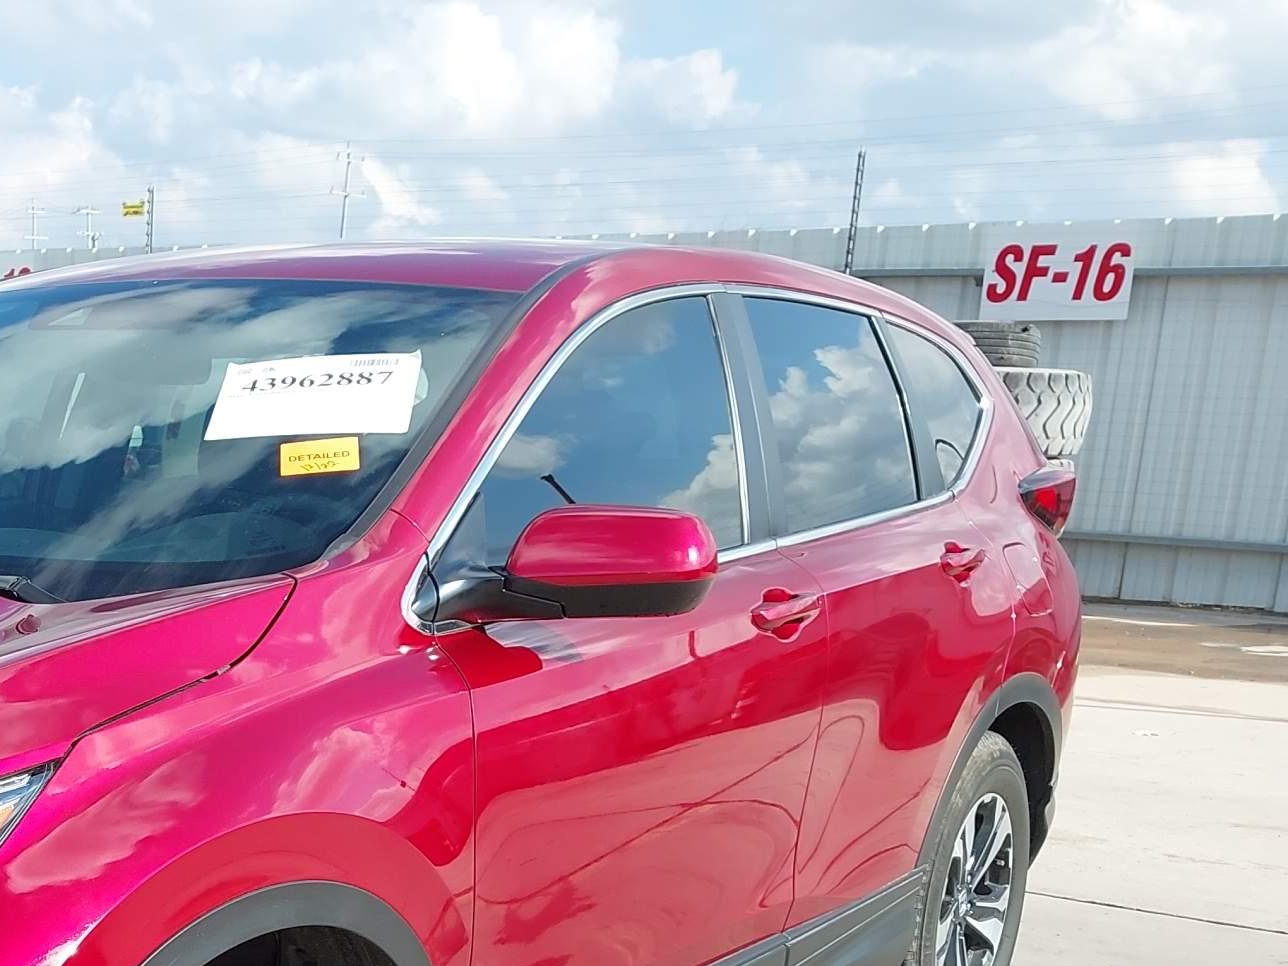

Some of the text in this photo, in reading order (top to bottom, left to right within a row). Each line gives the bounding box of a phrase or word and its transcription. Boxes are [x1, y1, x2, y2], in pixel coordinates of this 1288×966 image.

[985, 243, 1133, 304] SF-16
[241, 371, 394, 393] 43962887
[288, 450, 351, 463] DETAILED
